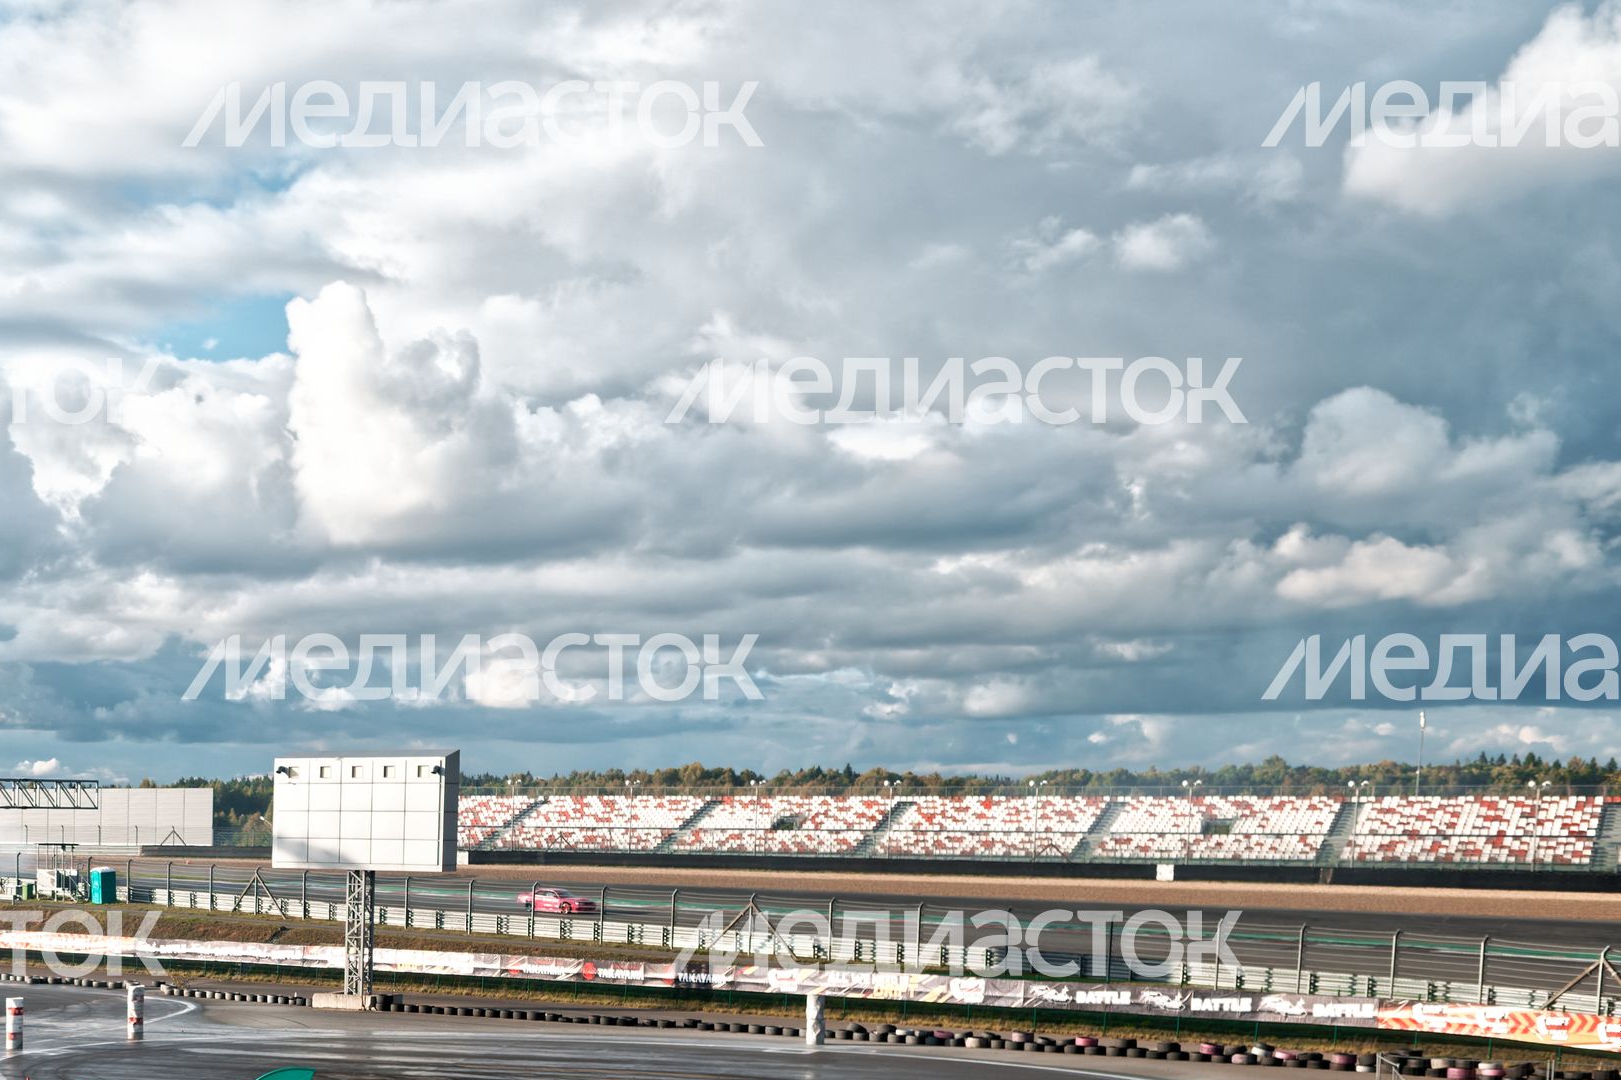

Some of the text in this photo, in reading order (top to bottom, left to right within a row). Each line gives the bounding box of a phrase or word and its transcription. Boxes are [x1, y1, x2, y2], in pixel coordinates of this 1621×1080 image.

[1076, 991, 1131, 1005] BATTLE
[1191, 997, 1252, 1012] BATTLE
[1313, 1003, 1374, 1018] BATTLE
